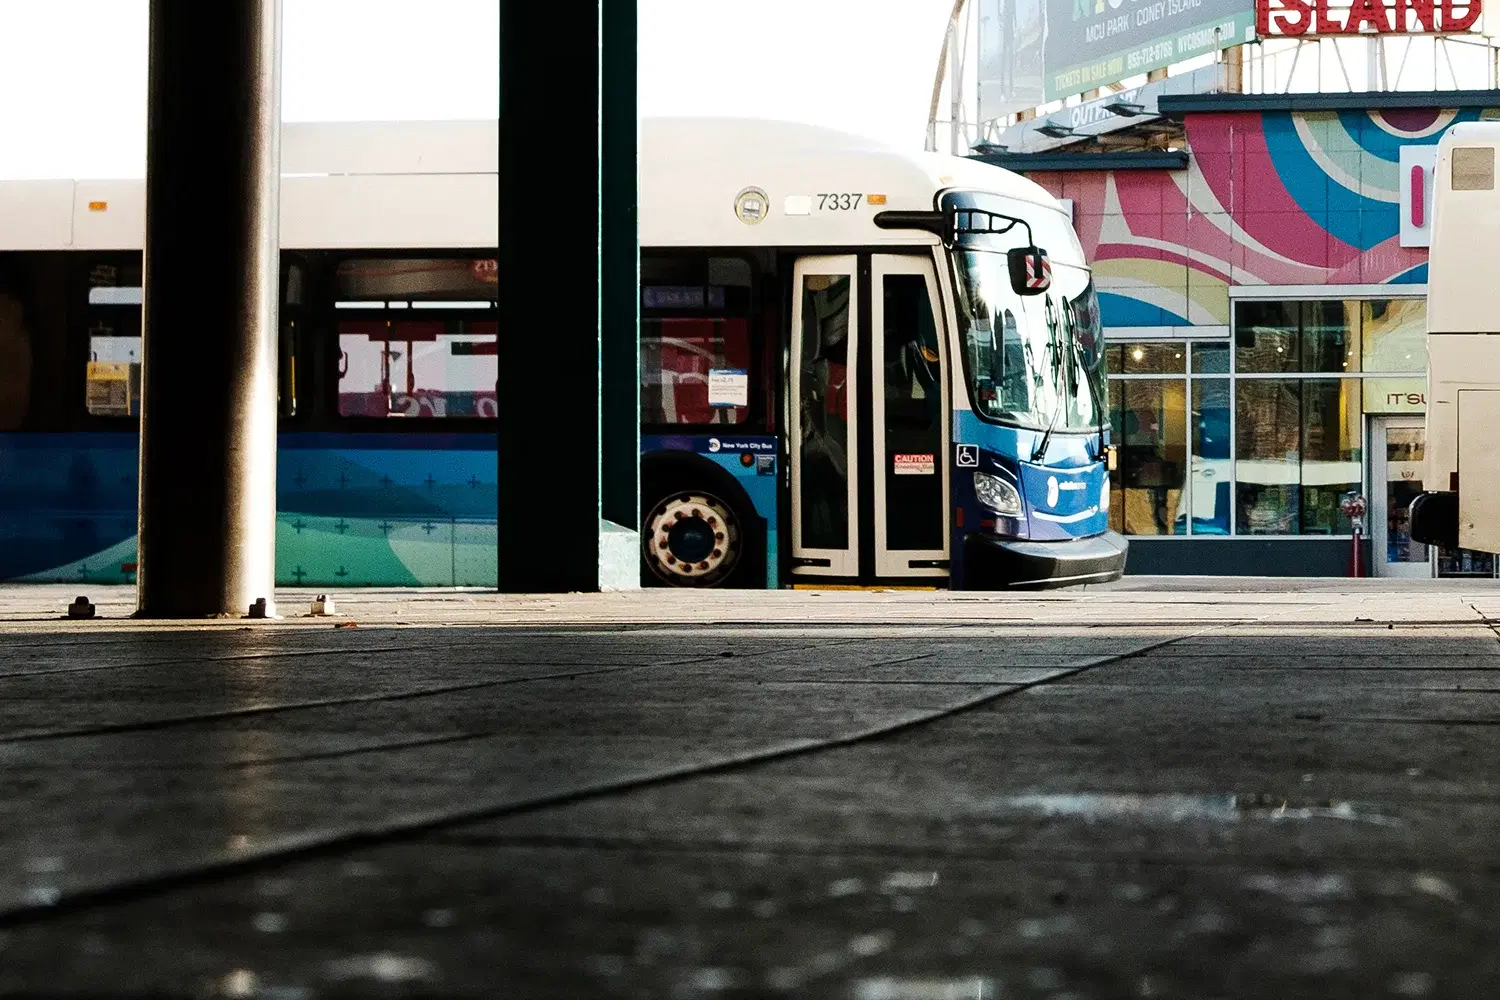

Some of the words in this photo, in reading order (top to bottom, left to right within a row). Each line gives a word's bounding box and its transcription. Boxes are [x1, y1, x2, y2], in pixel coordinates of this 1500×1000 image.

[1085, 25, 1105, 43] MCU
[1106, 13, 1130, 37] PARK
[1136, 4, 1166, 27] CONEY
[817, 193, 863, 211] 7337
[894, 454, 934, 463] CAUTION
